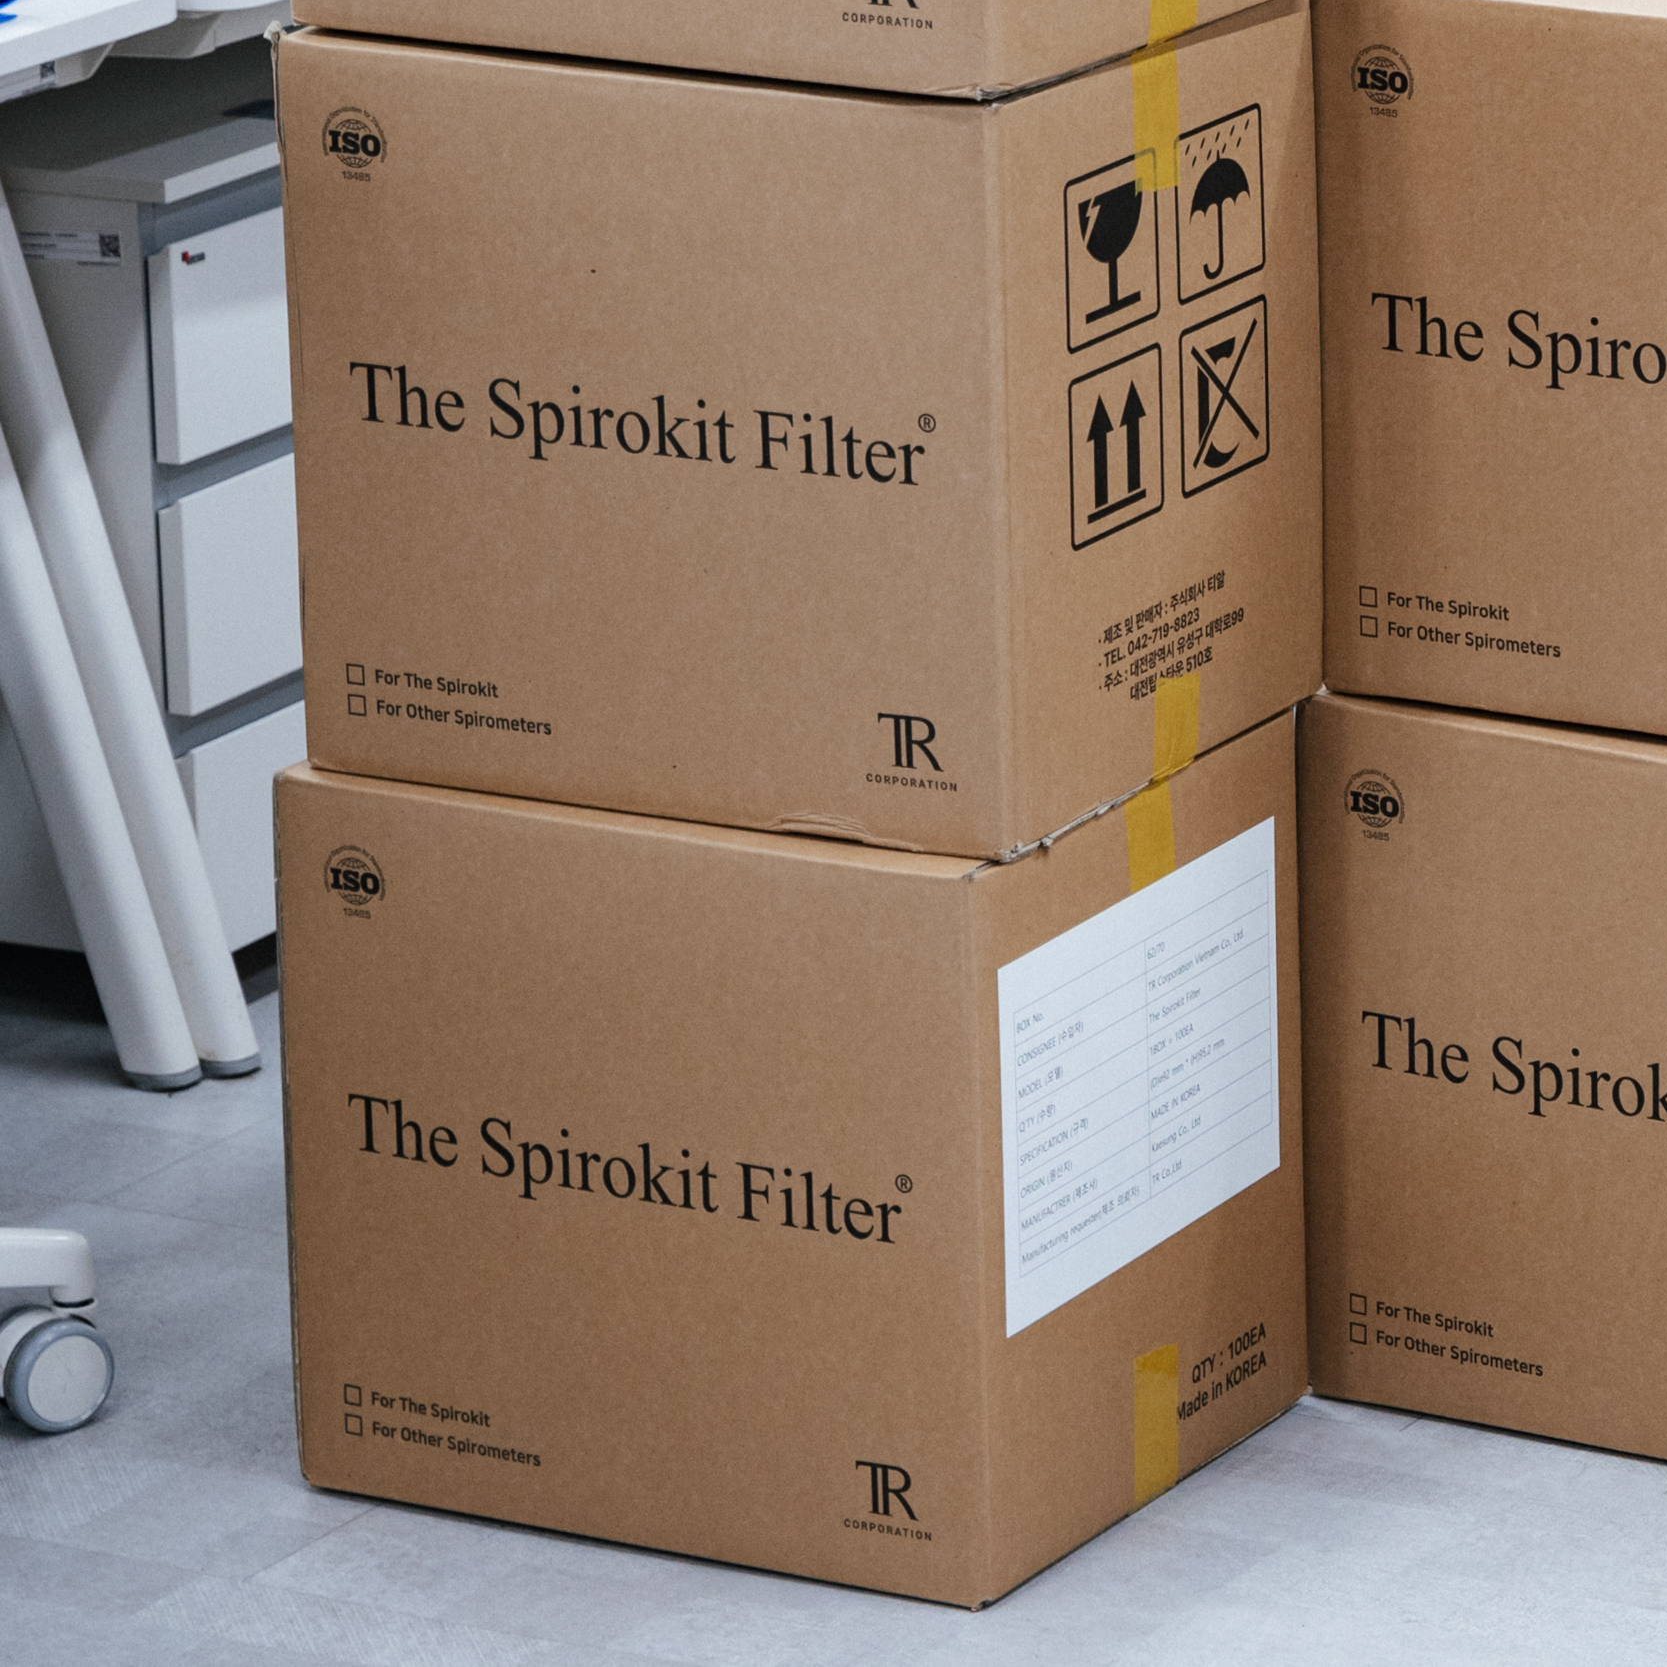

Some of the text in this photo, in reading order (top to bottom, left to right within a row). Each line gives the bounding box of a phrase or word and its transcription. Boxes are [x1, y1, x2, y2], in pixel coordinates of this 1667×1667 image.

[841, 11, 933, 30] CORPORATION
[1357, 67, 1408, 94] ISO
[328, 130, 381, 157] ISO
[1371, 292, 1484, 362] The
[349, 361, 465, 433] The
[488, 377, 736, 464] Spirokit
[1103, 570, 1225, 644] 제조 및 판매자 주식회사 티알
[1387, 591, 1510, 621] For The Spirokit
[1104, 607, 1200, 667] TEL. 042-719-8823
[1130, 640, 1175, 677] 대전광역시
[1177, 627, 1204, 655] 유성구
[1206, 607, 1244, 638] 대학로99
[1387, 620, 1561, 658] For Other Spirometers
[1186, 646, 1213, 672] 510호
[374, 668, 499, 699] For The Spirokit
[376, 698, 552, 736] For Other Spirometers
[865, 772, 957, 792] CORPORATION
[1350, 790, 1399, 818] ISO
[330, 867, 380, 895] ISO
[1016, 1016, 1030, 1034] BOX
[1017, 1035, 1055, 1068] CONSIGNEE
[1157, 956, 1193, 989] Corporation
[1018, 1076, 1042, 1101] MODEL
[1149, 1008, 1159, 1025] The
[1361, 1010, 1469, 1084] The
[347, 1093, 458, 1168] The
[480, 1117, 719, 1213] Spirokit
[1020, 1128, 1068, 1168] SPECIFICATION
[1021, 1175, 1044, 1200] ORIGIN
[1151, 1100, 1169, 1122] MADE
[1180, 1081, 1200, 1104] KOREA
[1376, 1300, 1494, 1338] For The Spirokit
[1192, 1322, 1266, 1384] QTY 100EA
[1376, 1329, 1543, 1377] For Other Spirometers
[1177, 1350, 1266, 1420] Made in KOREA
[370, 1390, 490, 1428] For The Spirokit
[372, 1420, 541, 1467] For Other Spirometers
[843, 1517, 932, 1541] CORPORATION
